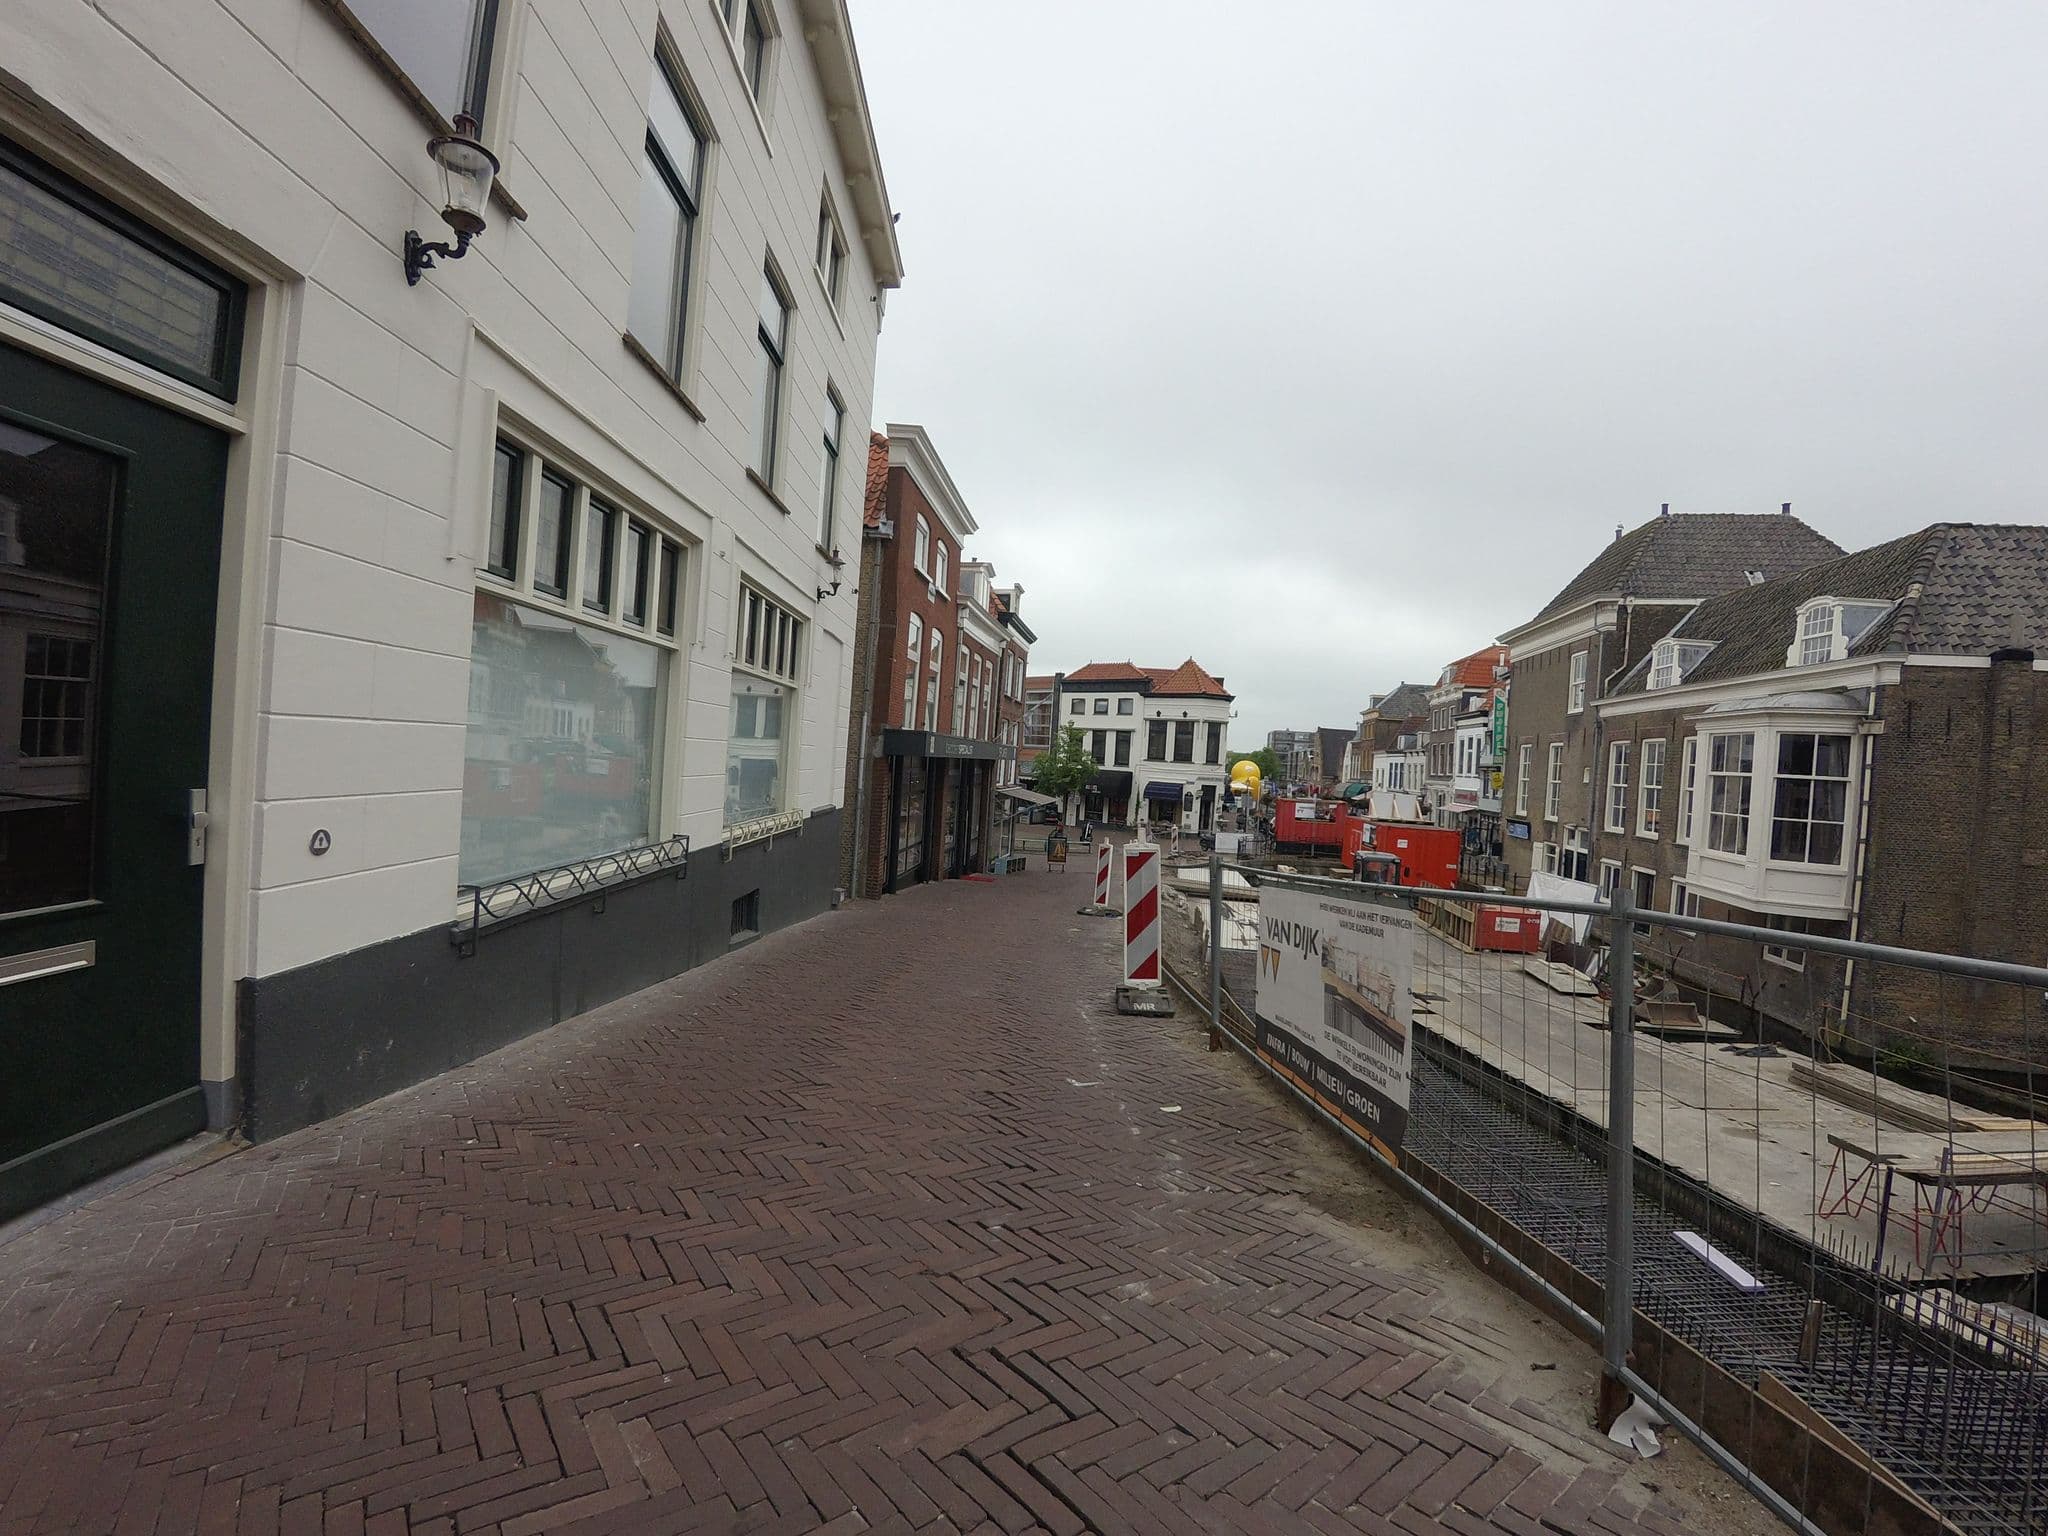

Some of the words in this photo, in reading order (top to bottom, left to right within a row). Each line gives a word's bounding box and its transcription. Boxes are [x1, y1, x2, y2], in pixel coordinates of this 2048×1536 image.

[1265, 916, 1291, 947] VAN
[1293, 926, 1319, 961] DIJK
[1348, 922, 1356, 931] DE
[1356, 924, 1385, 939] KADEMUUR
[1356, 910, 1367, 921] AAN
[1367, 912, 1378, 922] HET
[1379, 914, 1413, 930] VERVANGEN
[1331, 1034, 1352, 1052] WINKELS
[1357, 1049, 1388, 1075] WONINGEN
[1388, 1065, 1402, 1083] ZIJN
[1352, 1060, 1387, 1089] BEREIKBAAR
[1266, 1032, 1287, 1056] INFRA
[1291, 1047, 1311, 1075] BOUW
[1316, 1065, 1344, 1096] MILIEU
[1346, 1089, 1381, 1124] GROEN
